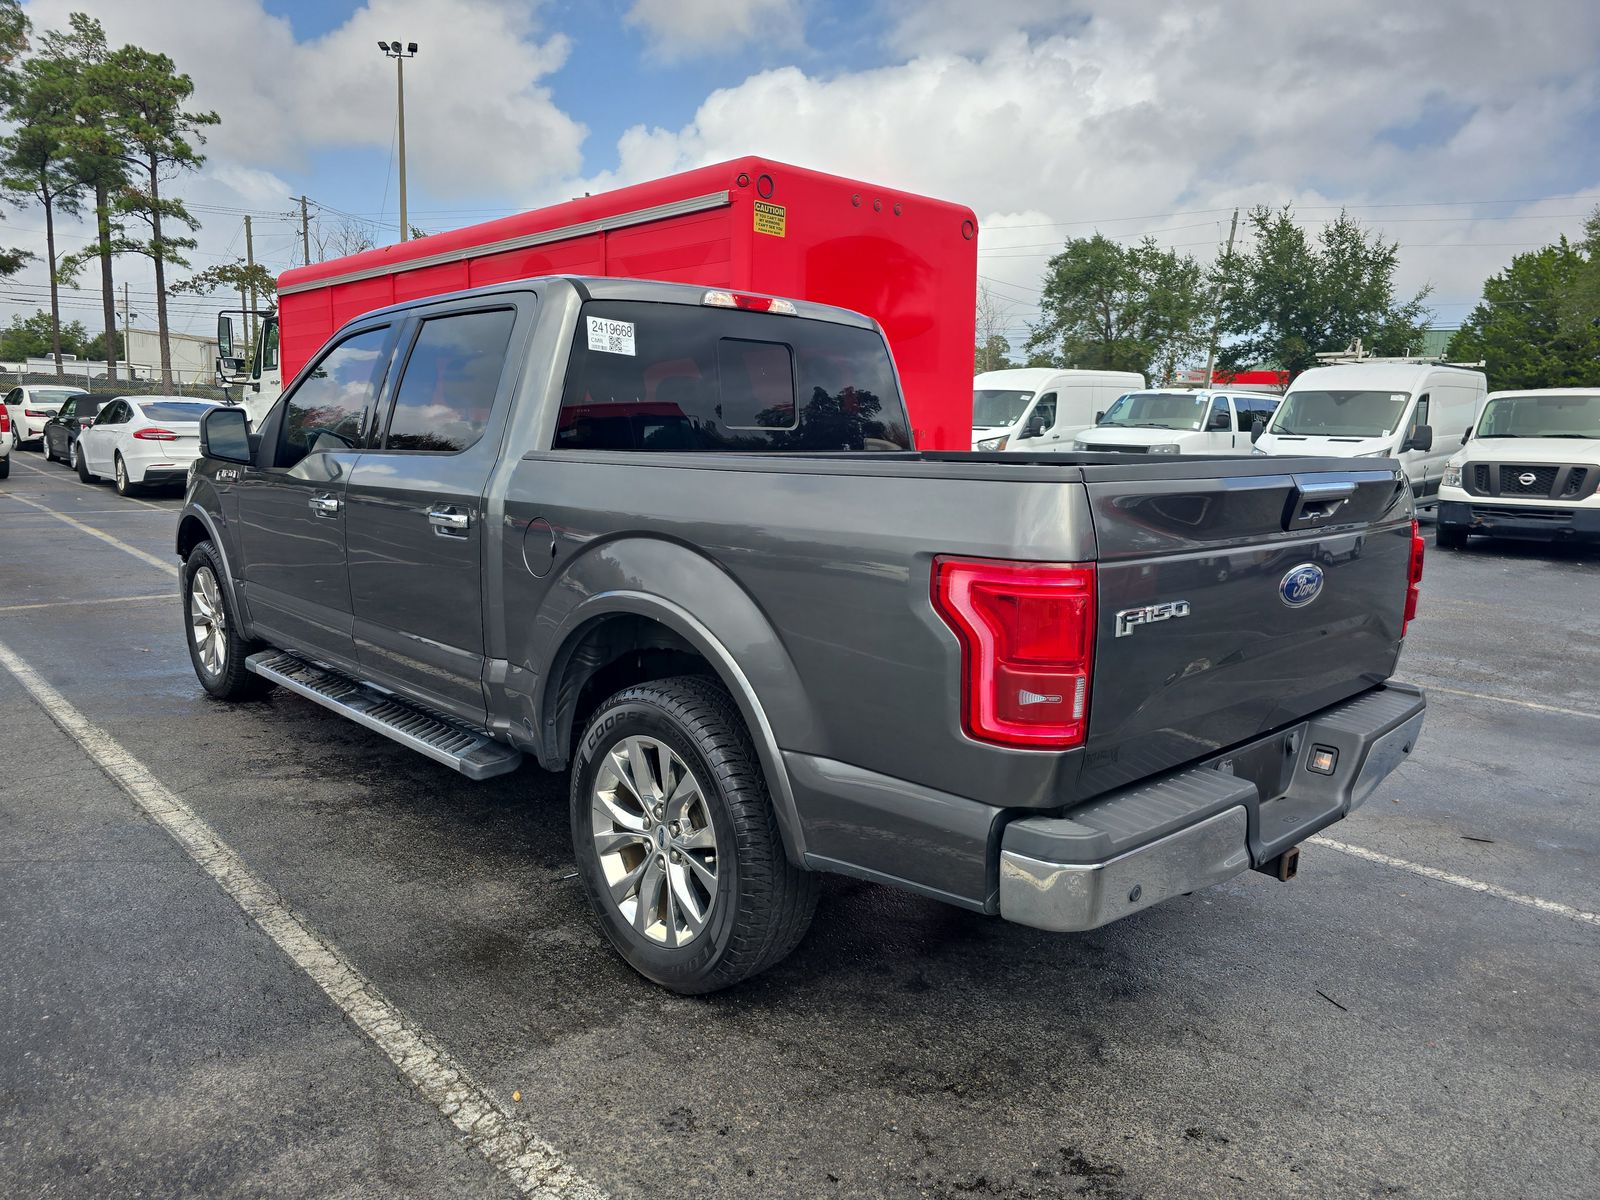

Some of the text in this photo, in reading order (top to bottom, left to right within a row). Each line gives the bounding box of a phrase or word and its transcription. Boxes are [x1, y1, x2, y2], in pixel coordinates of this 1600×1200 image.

[755, 203, 784, 216] CAUTION
[591, 320, 633, 338] 2419668
[1292, 572, 1318, 598] Ford
